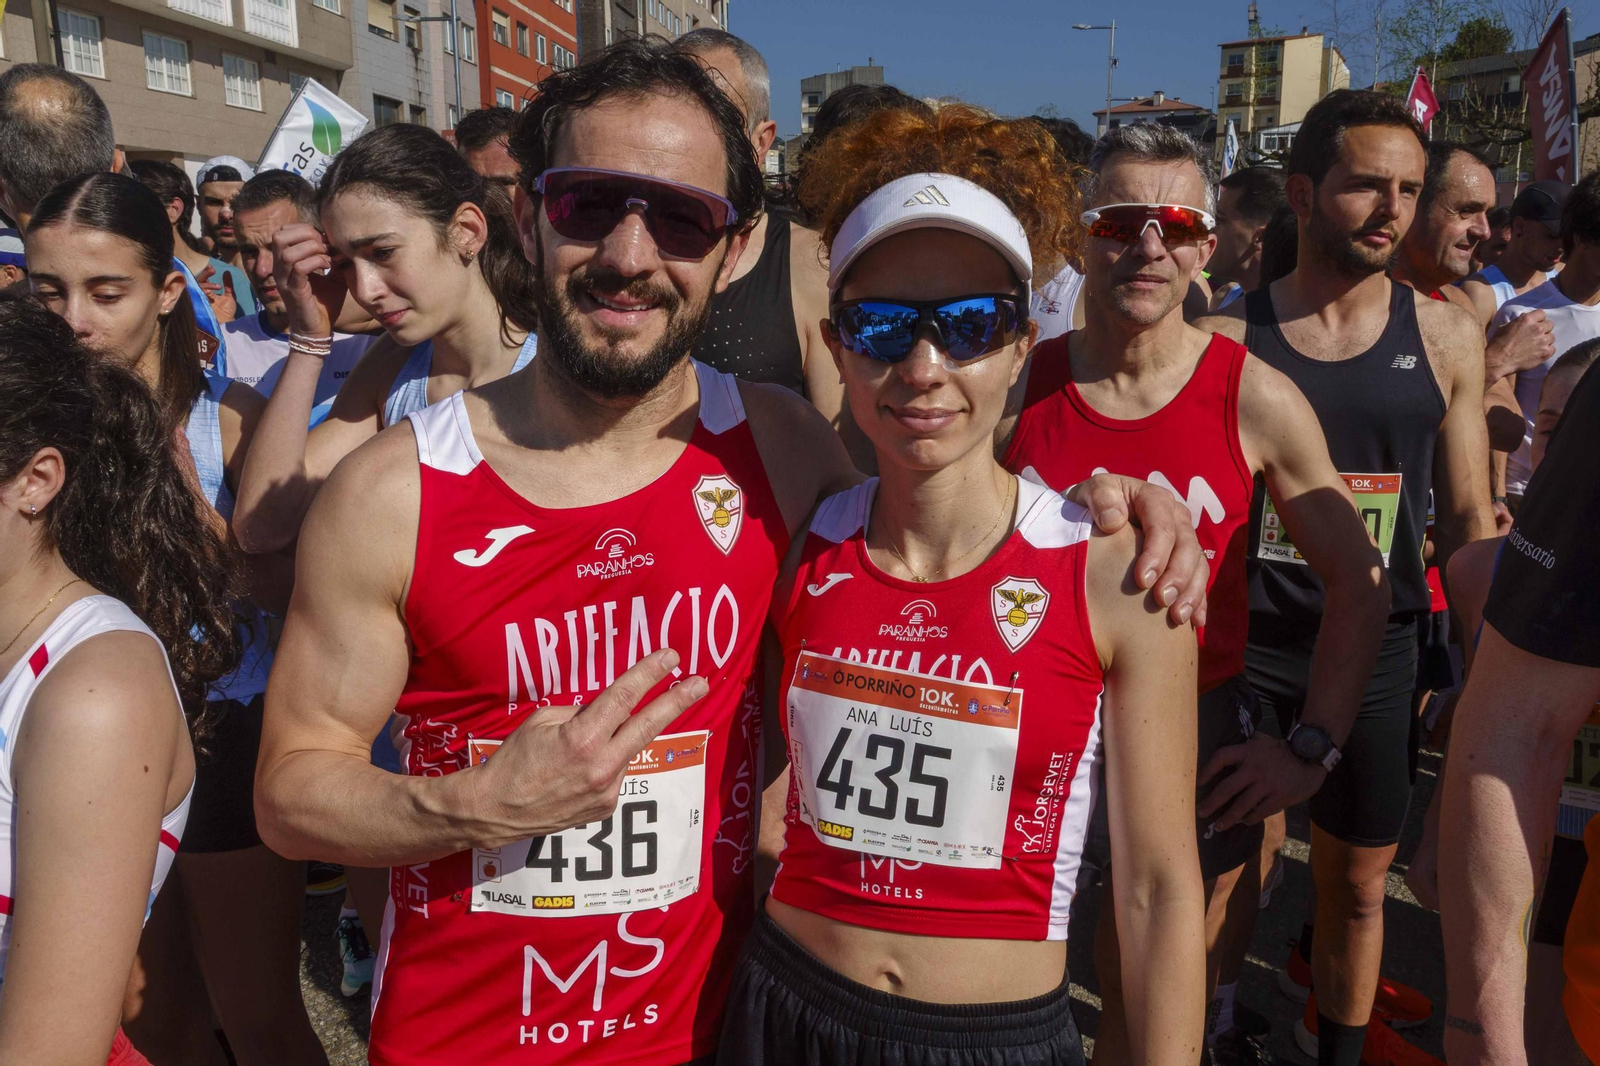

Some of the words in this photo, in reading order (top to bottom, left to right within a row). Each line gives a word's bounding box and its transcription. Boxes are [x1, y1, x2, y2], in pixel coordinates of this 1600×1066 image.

[576, 552, 655, 579] PARANHOS
[600, 568, 632, 580] FREGUESIA
[878, 623, 949, 639] PARANHOS
[895, 635, 926, 643] FREGUESIA
[846, 673, 916, 699] PORRIÑO
[846, 706, 878, 726] ANA
[889, 717, 933, 737] LUÍS
[619, 778, 649, 797] UÍS
[816, 726, 953, 828] 435
[996, 775, 1006, 792] 435
[1052, 752, 1074, 809] VEERINÁRIAS
[1032, 751, 1064, 828] JORGEVET
[525, 799, 658, 883] 436
[818, 820, 854, 840] GADIS
[491, 891, 527, 906] LASAL
[533, 896, 574, 908] GADIS
[860, 881, 924, 900] HOTELS
[522, 904, 669, 1017] MS
[519, 1003, 659, 1045] HOTELS
